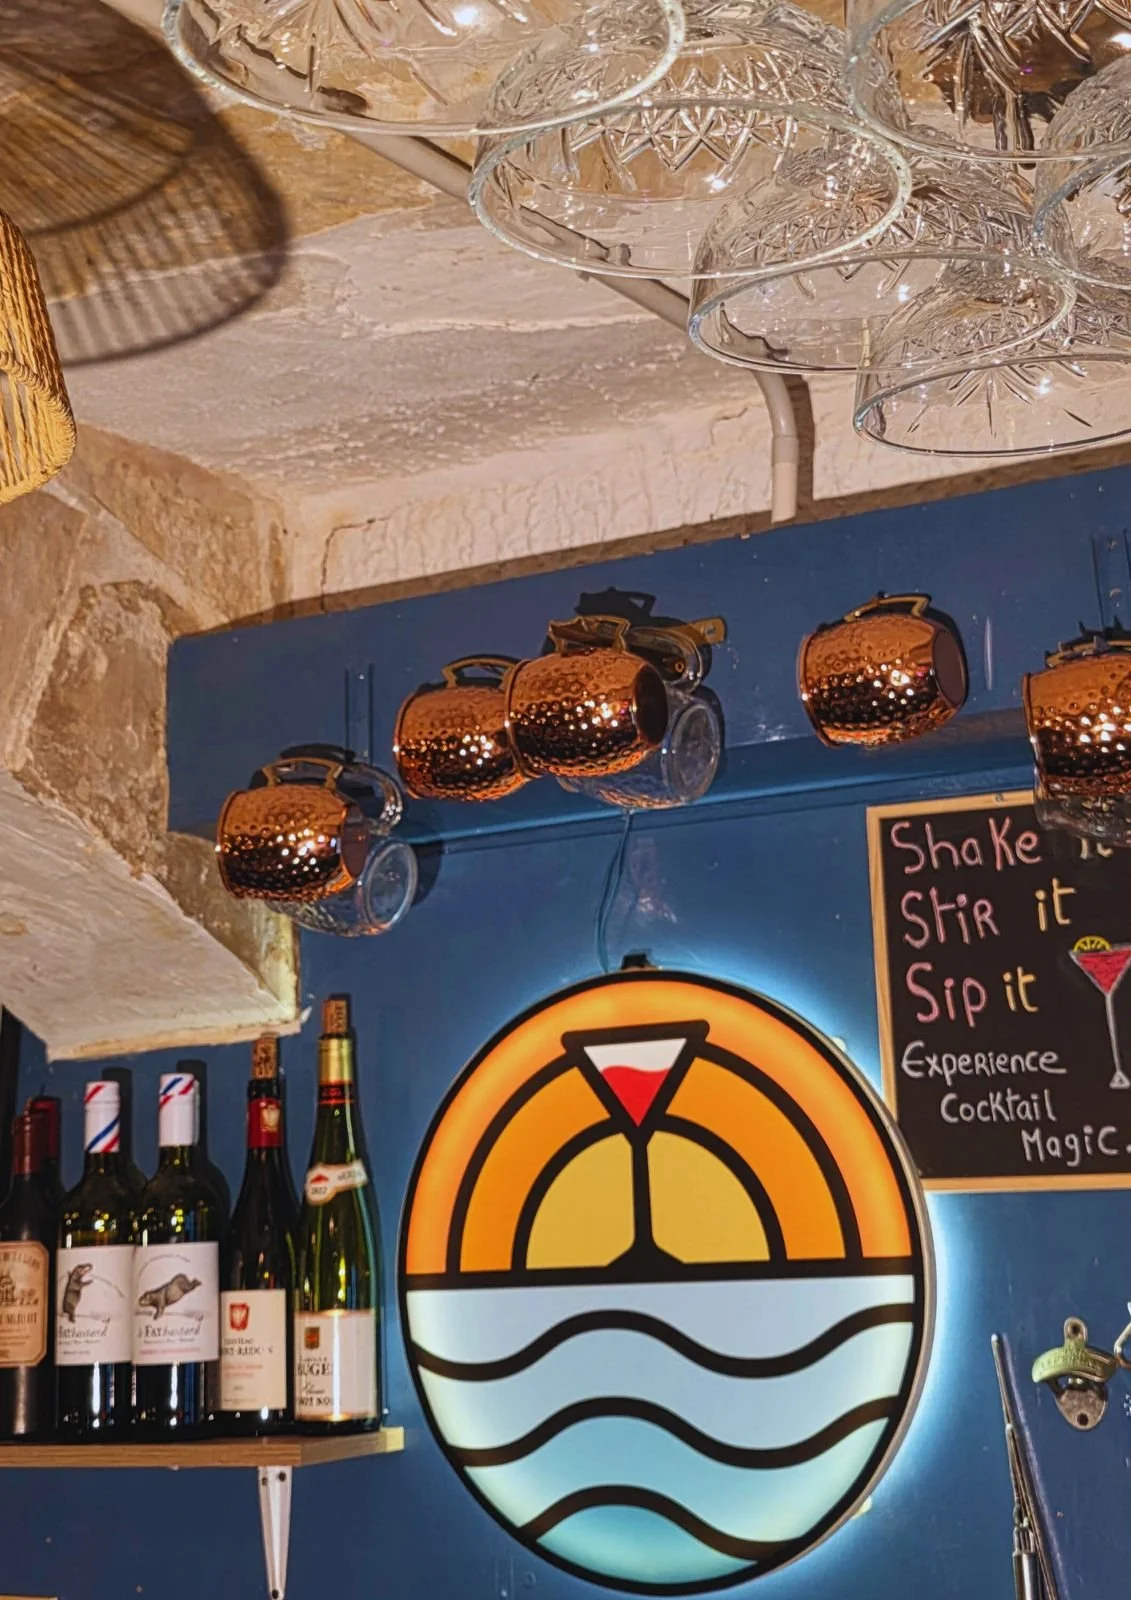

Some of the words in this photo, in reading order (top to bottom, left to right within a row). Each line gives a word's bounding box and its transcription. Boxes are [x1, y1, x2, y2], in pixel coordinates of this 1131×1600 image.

[1035, 877, 1076, 931] it
[906, 962, 988, 1027] Sip
[1003, 966, 1039, 1012] it
